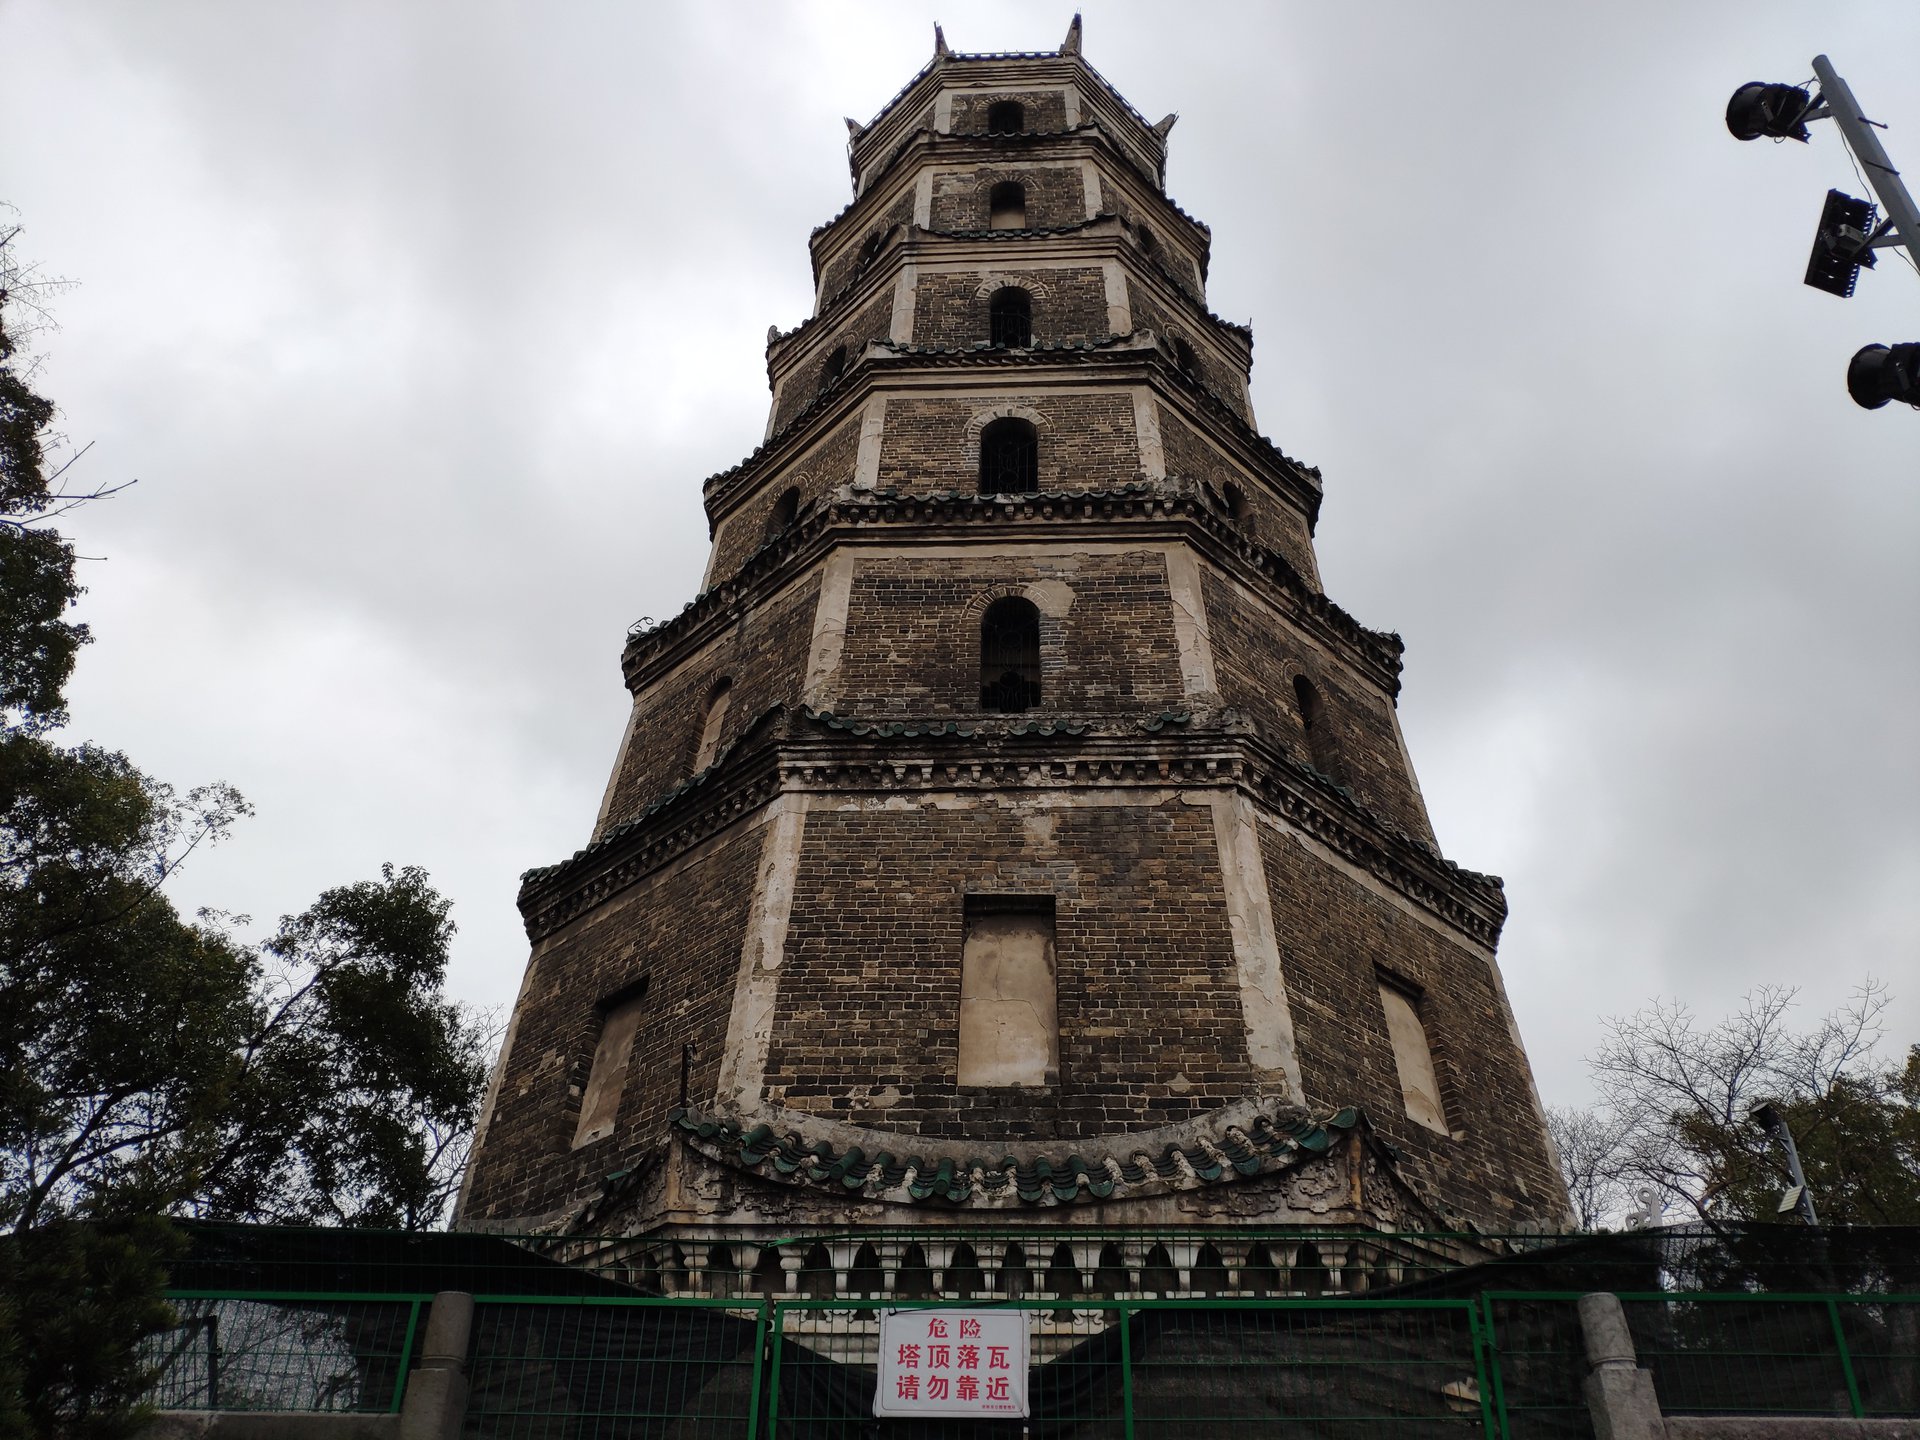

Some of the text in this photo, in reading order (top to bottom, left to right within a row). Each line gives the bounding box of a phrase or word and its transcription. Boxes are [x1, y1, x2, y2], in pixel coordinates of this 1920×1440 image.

[927, 1318, 982, 1339] 危险
[897, 1344, 1010, 1369] 塔顶落瓦
[896, 1375, 1009, 1401] 请勿靠近
